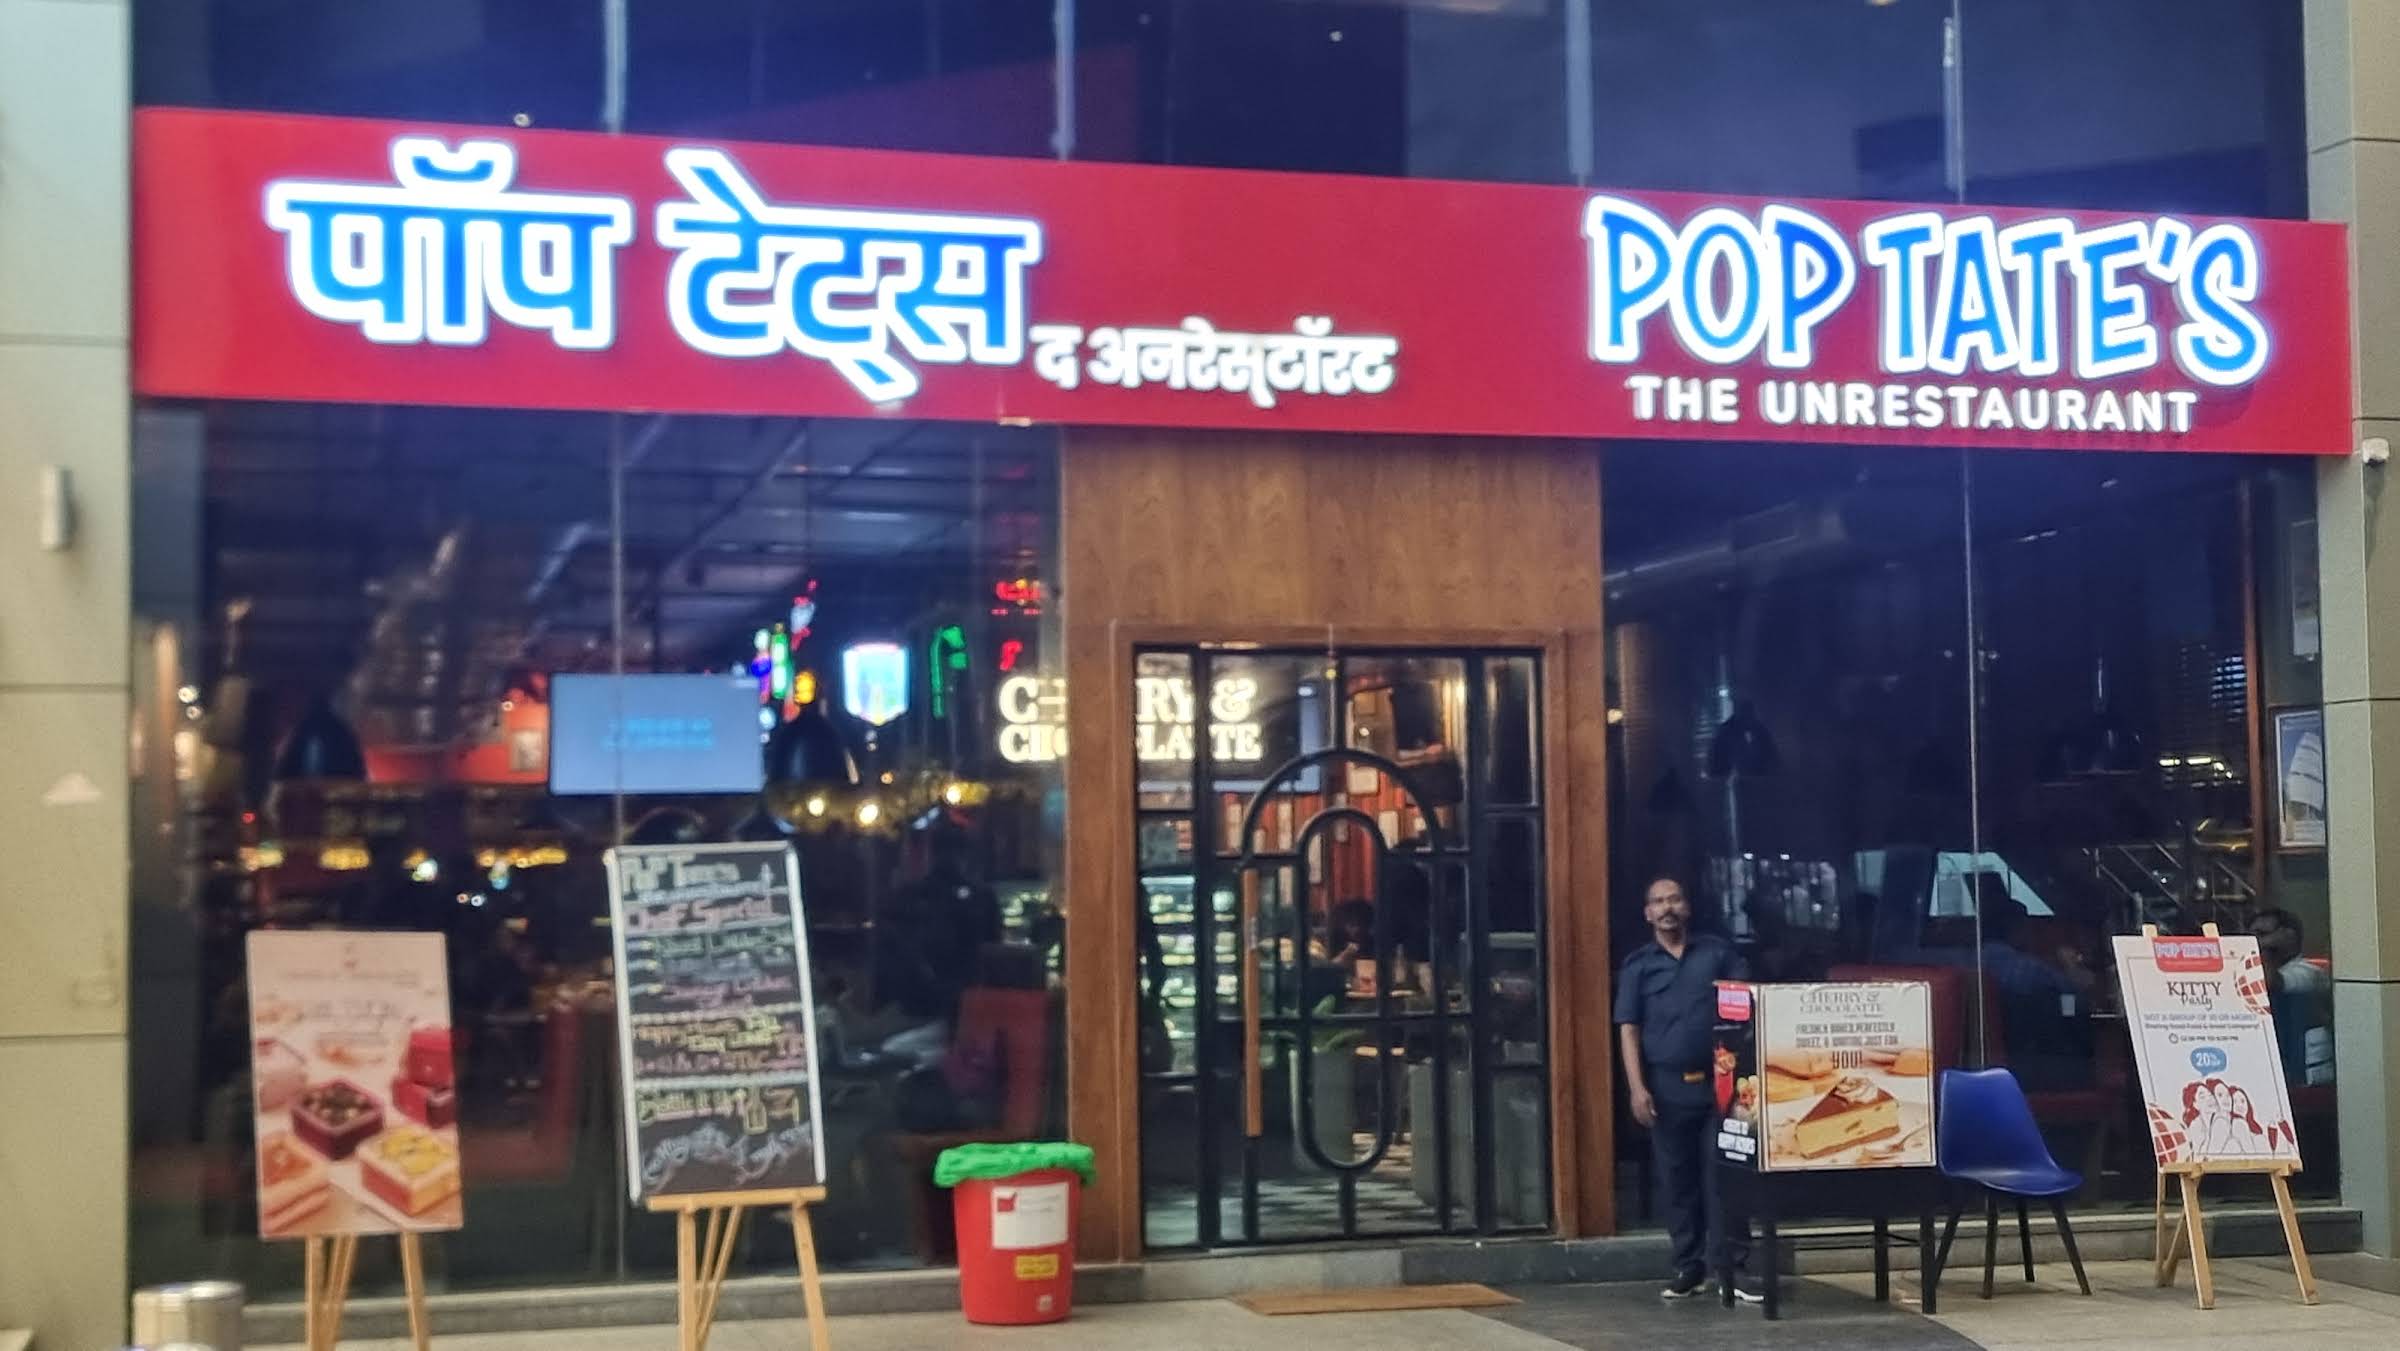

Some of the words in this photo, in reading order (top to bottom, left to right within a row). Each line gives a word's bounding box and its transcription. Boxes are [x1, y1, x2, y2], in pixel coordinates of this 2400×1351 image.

[265, 136, 633, 350] पॉप
[656, 145, 1044, 404] टेट्स
[1584, 194, 1857, 370] POP
[1864, 211, 2270, 388] TATE'S
[1030, 325, 1084, 390] द
[1627, 375, 1740, 423] THE
[1761, 379, 2197, 435] UNRESTAURANT
[1210, 678, 1258, 723] &
[1800, 991, 1862, 1004] CHERRY
[2166, 981, 2221, 996] KITTY
[2181, 994, 2213, 1010] Party
[1831, 1051, 1864, 1070] YOU!
